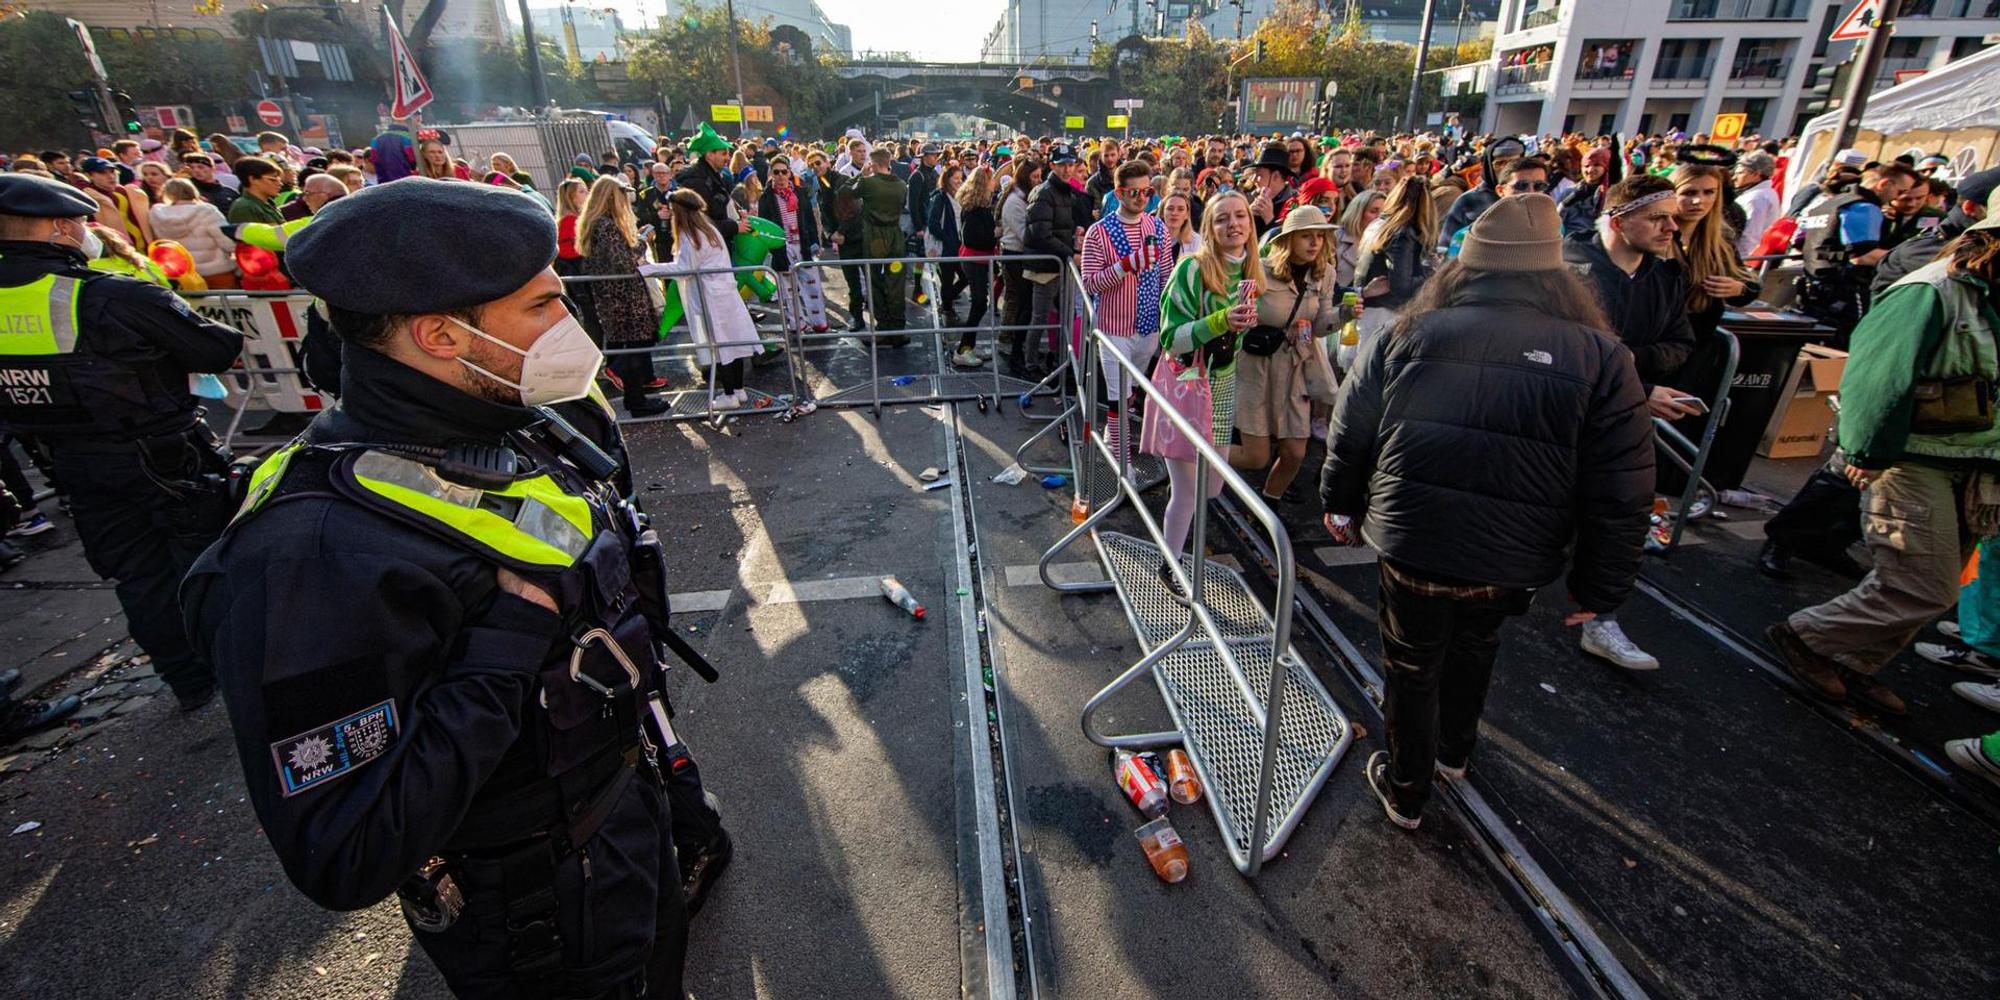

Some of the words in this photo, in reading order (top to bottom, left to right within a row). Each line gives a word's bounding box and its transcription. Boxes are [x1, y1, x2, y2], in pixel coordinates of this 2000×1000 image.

[0, 369, 51, 386] NRW
[1743, 373, 1772, 385] AWB
[5, 387, 53, 404] 1521
[359, 710, 384, 726] BPH
[301, 763, 334, 783] NRW
